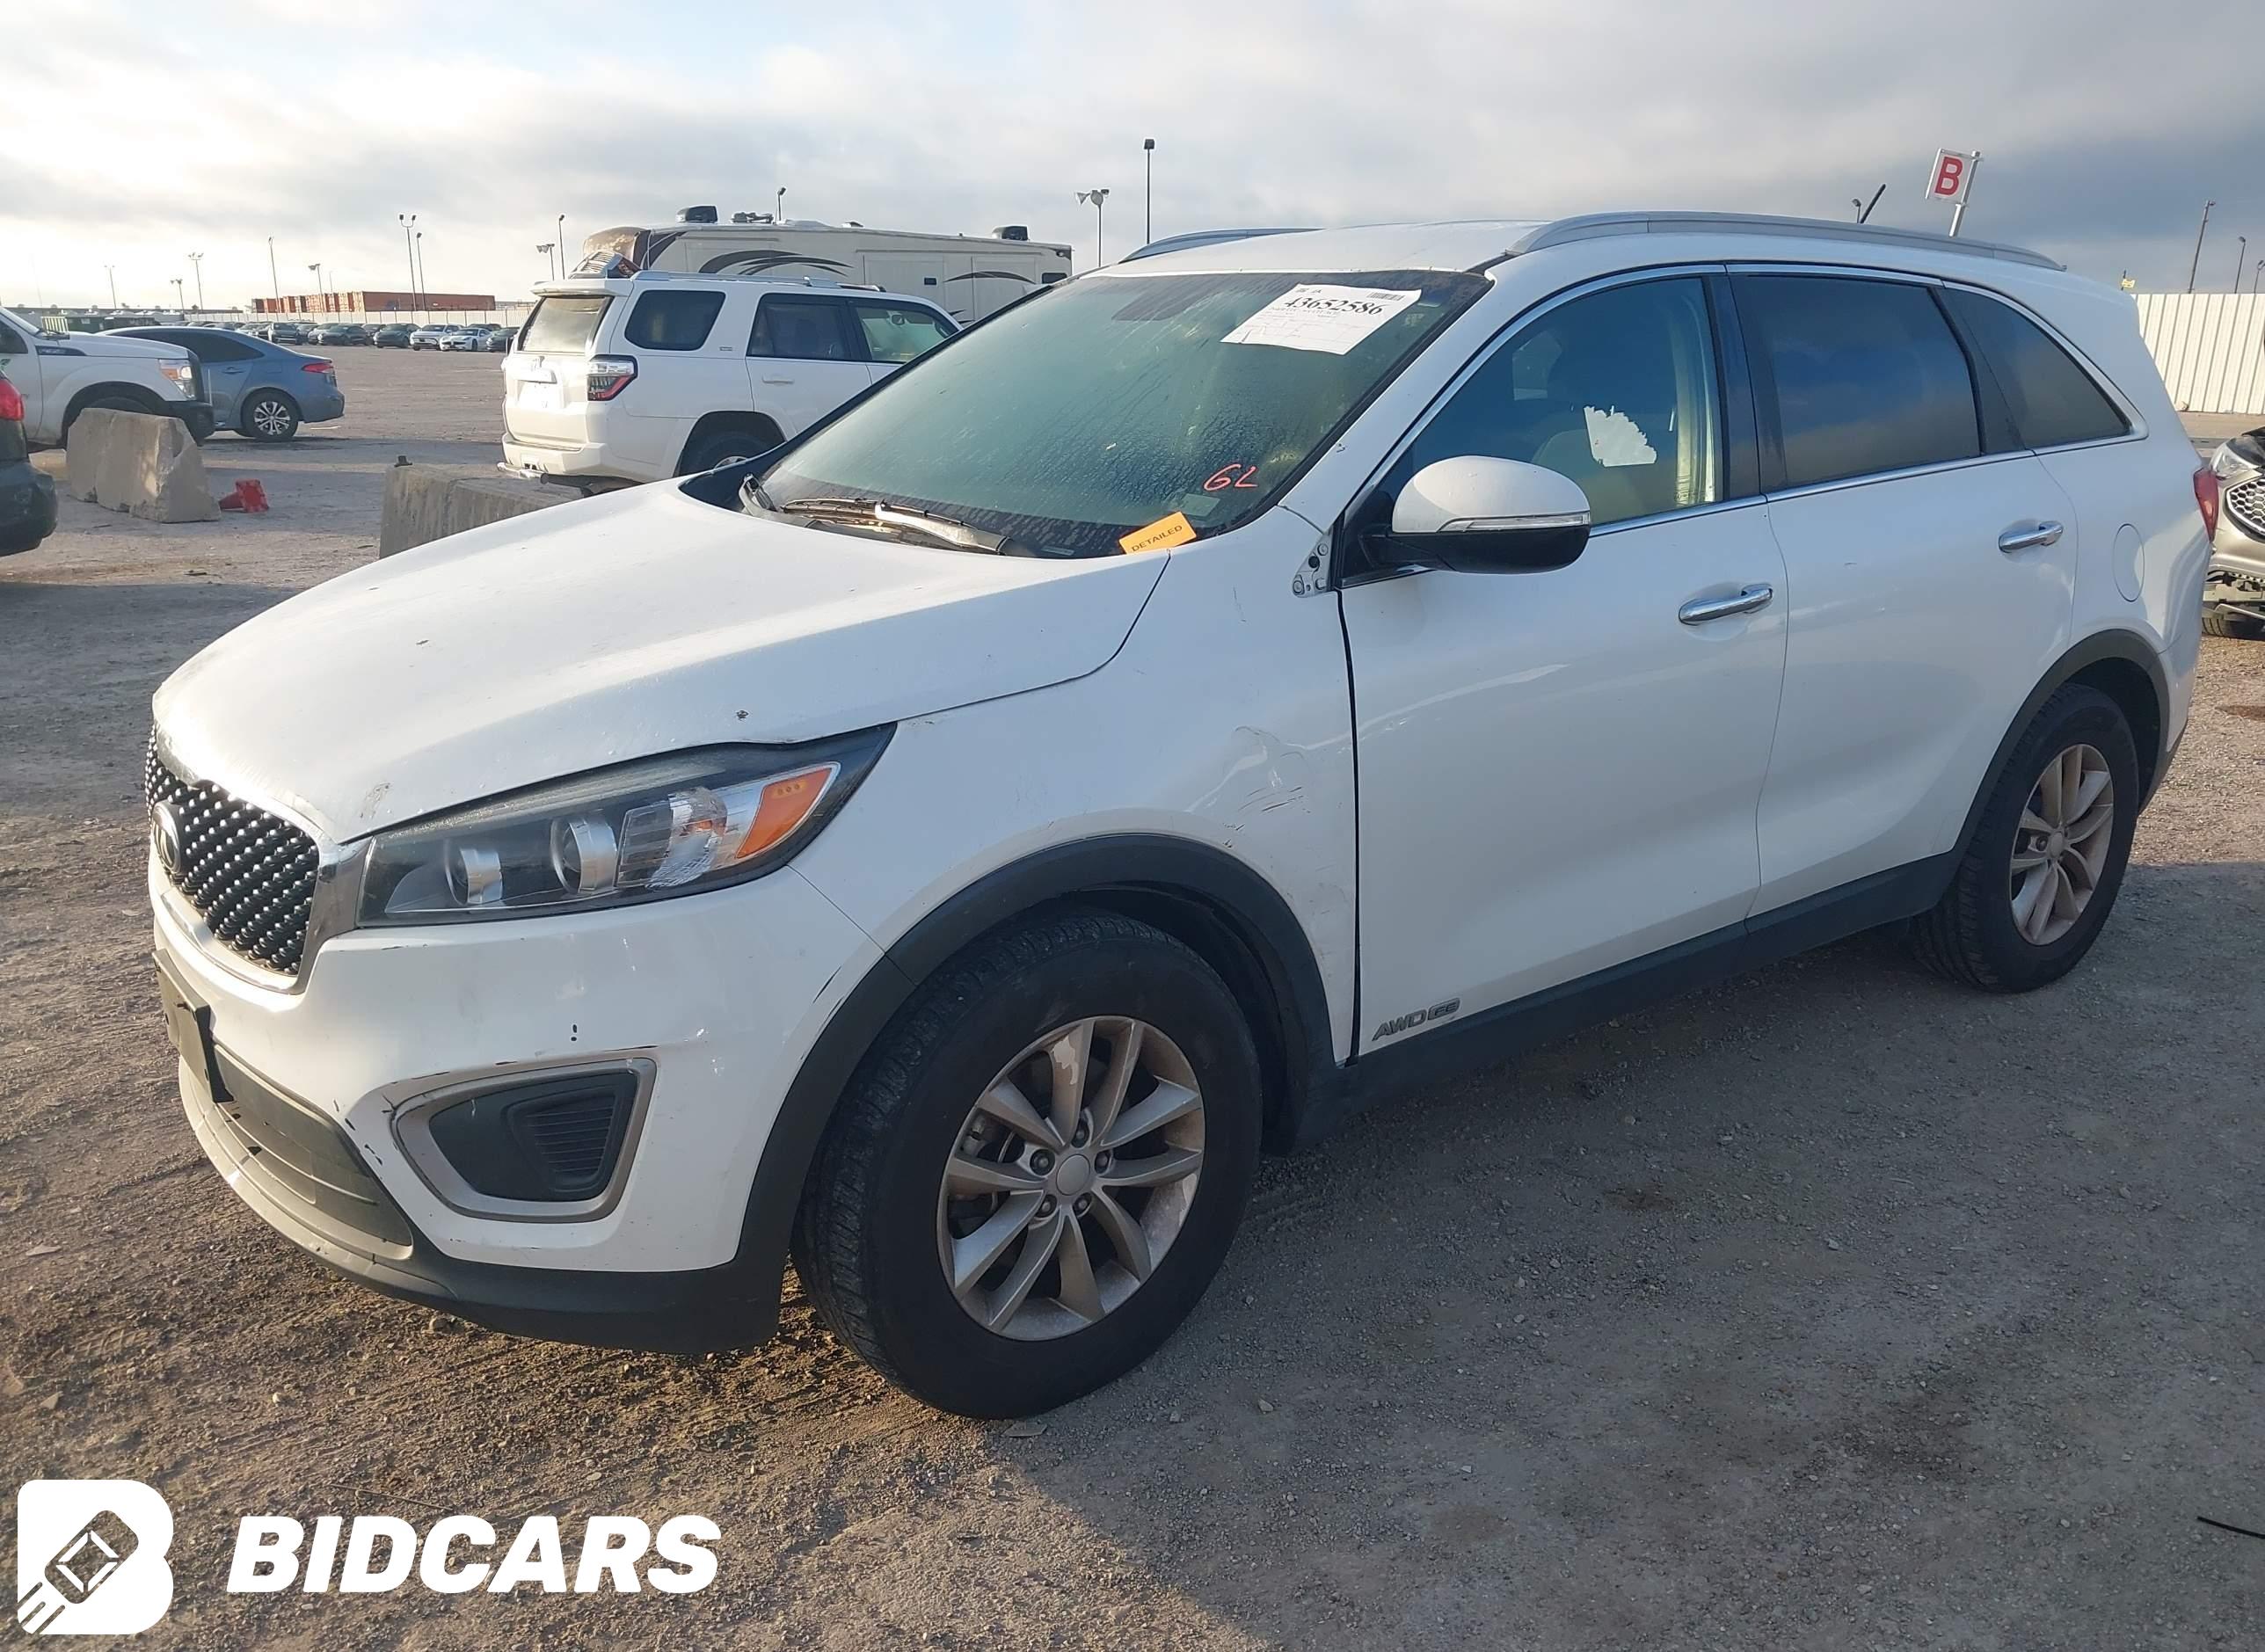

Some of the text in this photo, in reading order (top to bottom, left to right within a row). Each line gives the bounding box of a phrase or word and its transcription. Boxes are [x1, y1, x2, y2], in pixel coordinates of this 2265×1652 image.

[1934, 156, 1963, 195] B
[1284, 296, 1388, 316] 43652586
[1131, 525, 1183, 552] DETAILED
[1372, 1008, 1427, 1041] AWD
